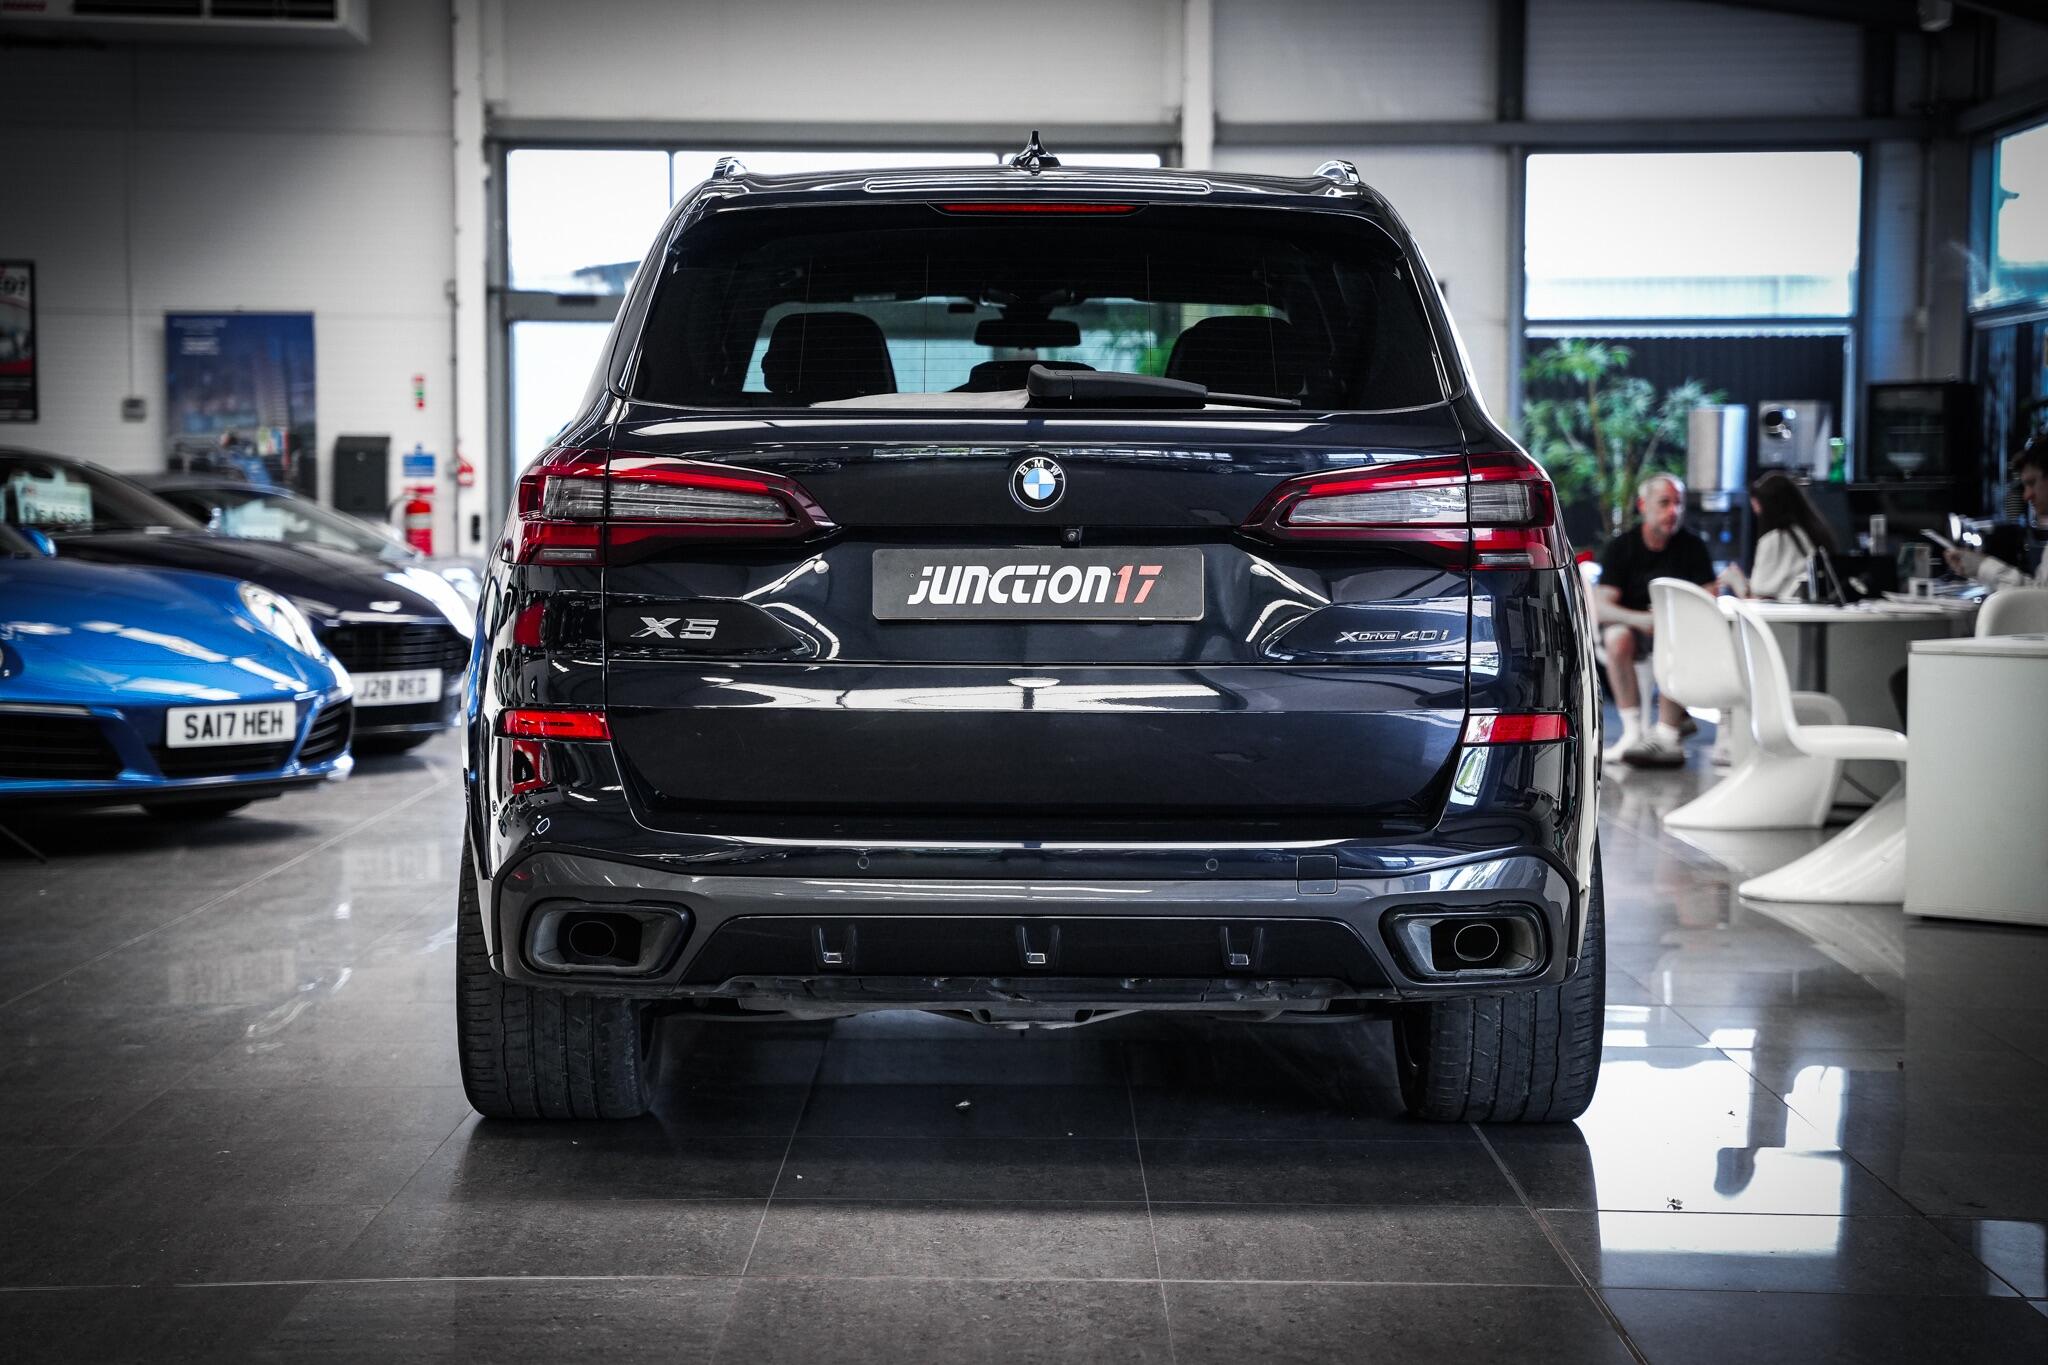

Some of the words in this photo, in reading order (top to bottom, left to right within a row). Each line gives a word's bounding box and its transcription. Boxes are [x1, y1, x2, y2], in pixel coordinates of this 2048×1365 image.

[1018, 459, 1061, 475] BMW
[630, 616, 720, 640] X5
[185, 713, 236, 739] SA17
[243, 710, 282, 735] HEH
